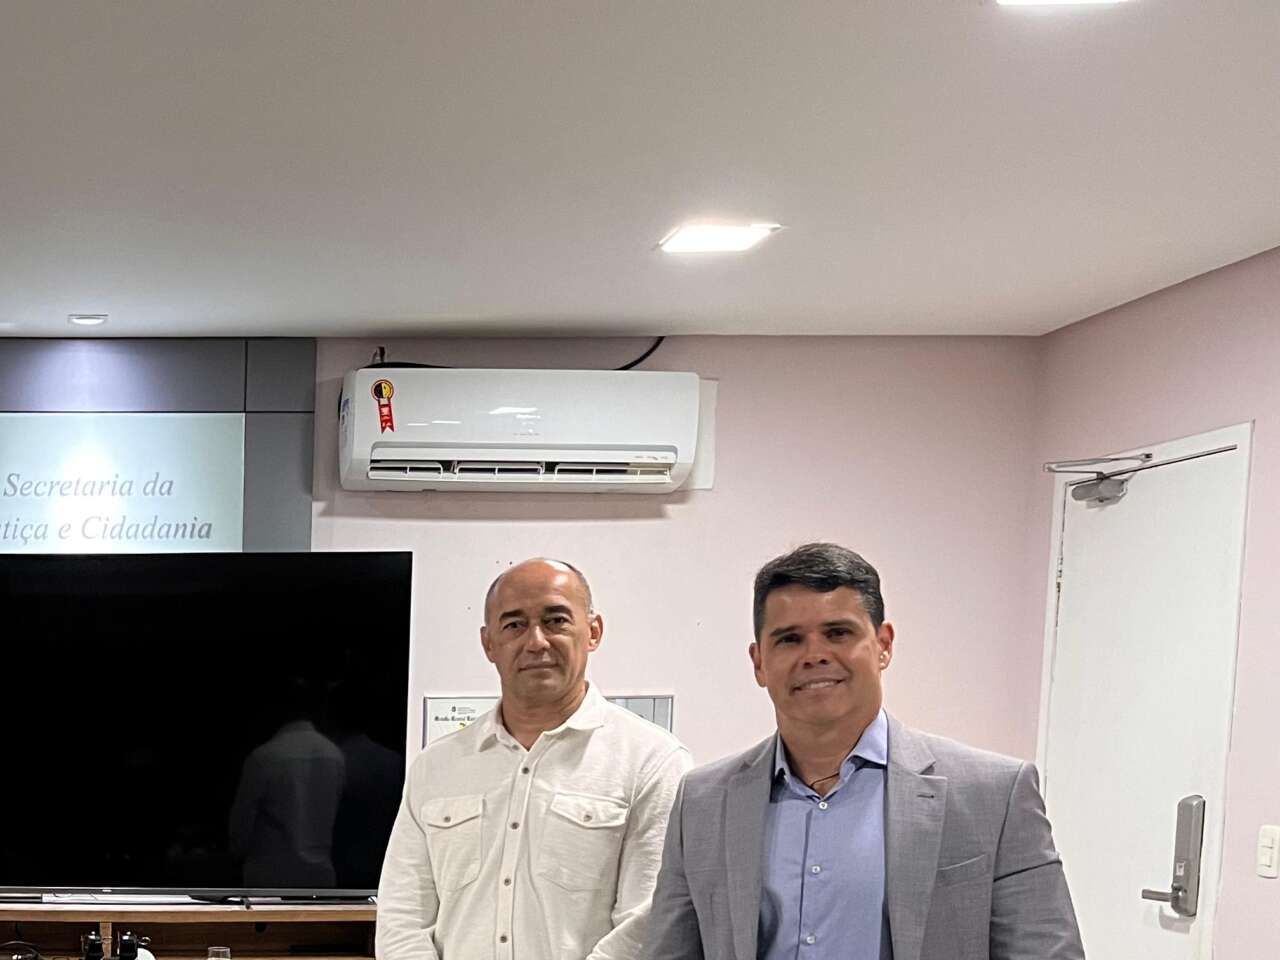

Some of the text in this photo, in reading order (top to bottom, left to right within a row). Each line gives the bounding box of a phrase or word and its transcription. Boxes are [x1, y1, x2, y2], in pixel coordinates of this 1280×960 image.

[3, 472, 174, 498] Secretaria da
[57, 523, 71, 540] e
[80, 515, 213, 540] Cidadania
